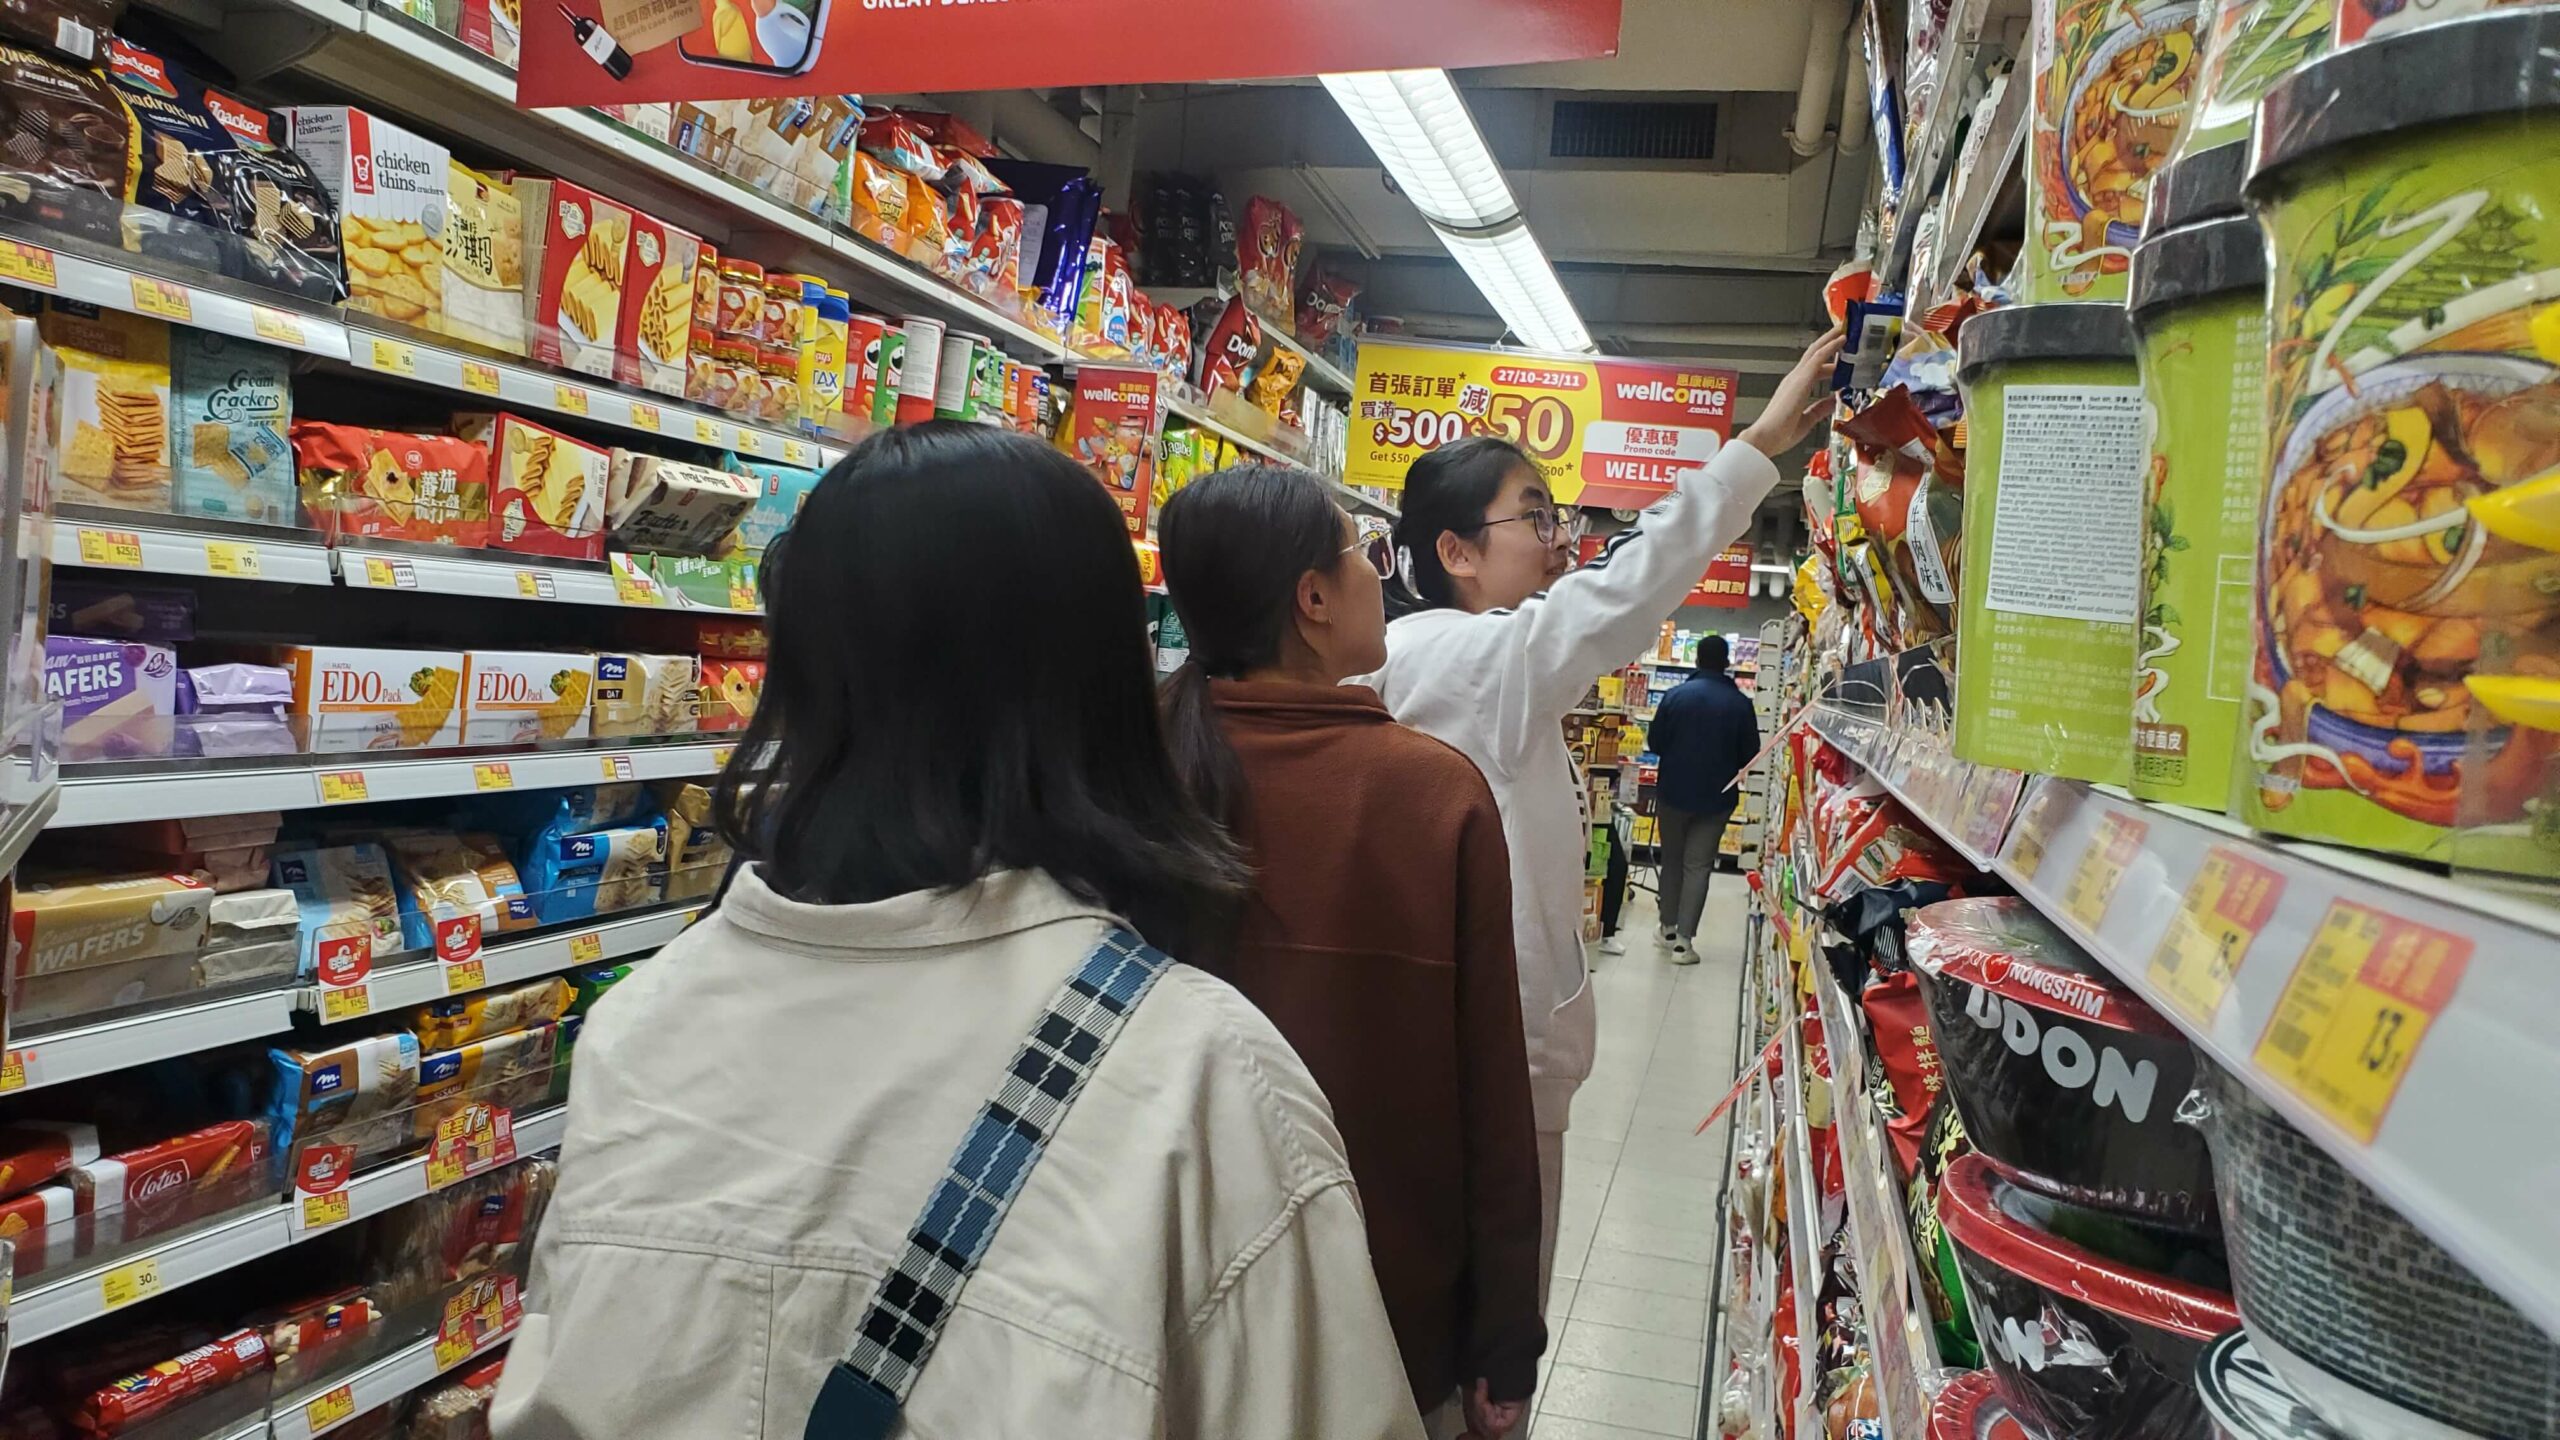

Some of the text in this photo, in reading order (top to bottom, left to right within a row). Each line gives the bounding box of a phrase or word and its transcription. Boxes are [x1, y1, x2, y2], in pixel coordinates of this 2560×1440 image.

[376, 150, 431, 175] chicken
[378, 170, 445, 196] thins crackers
[228, 368, 275, 392] Cream
[813, 370, 838, 388] TAX
[206, 387, 279, 416] Crackers
[1083, 388, 1150, 404] wellcome
[1459, 385, 1490, 414] 減
[1616, 382, 1727, 406] wellcome
[1360, 401, 1396, 419] 買滿
[1687, 407, 1724, 416] .com.hk
[1625, 427, 1679, 447] 優惠碼
[1370, 451, 1410, 464] Get $50
[1624, 444, 1676, 457] Promo code
[1605, 460, 1687, 484] WELL5
[116, 545, 139, 558] $25/2
[44, 662, 123, 697] AFERS
[320, 671, 402, 703] EDO Pack
[477, 673, 544, 702] EDO Pack
[35, 922, 147, 974] WAFERS
[2008, 960, 2106, 1018] NONGSHIM
[1965, 982, 2158, 1123] UDON
